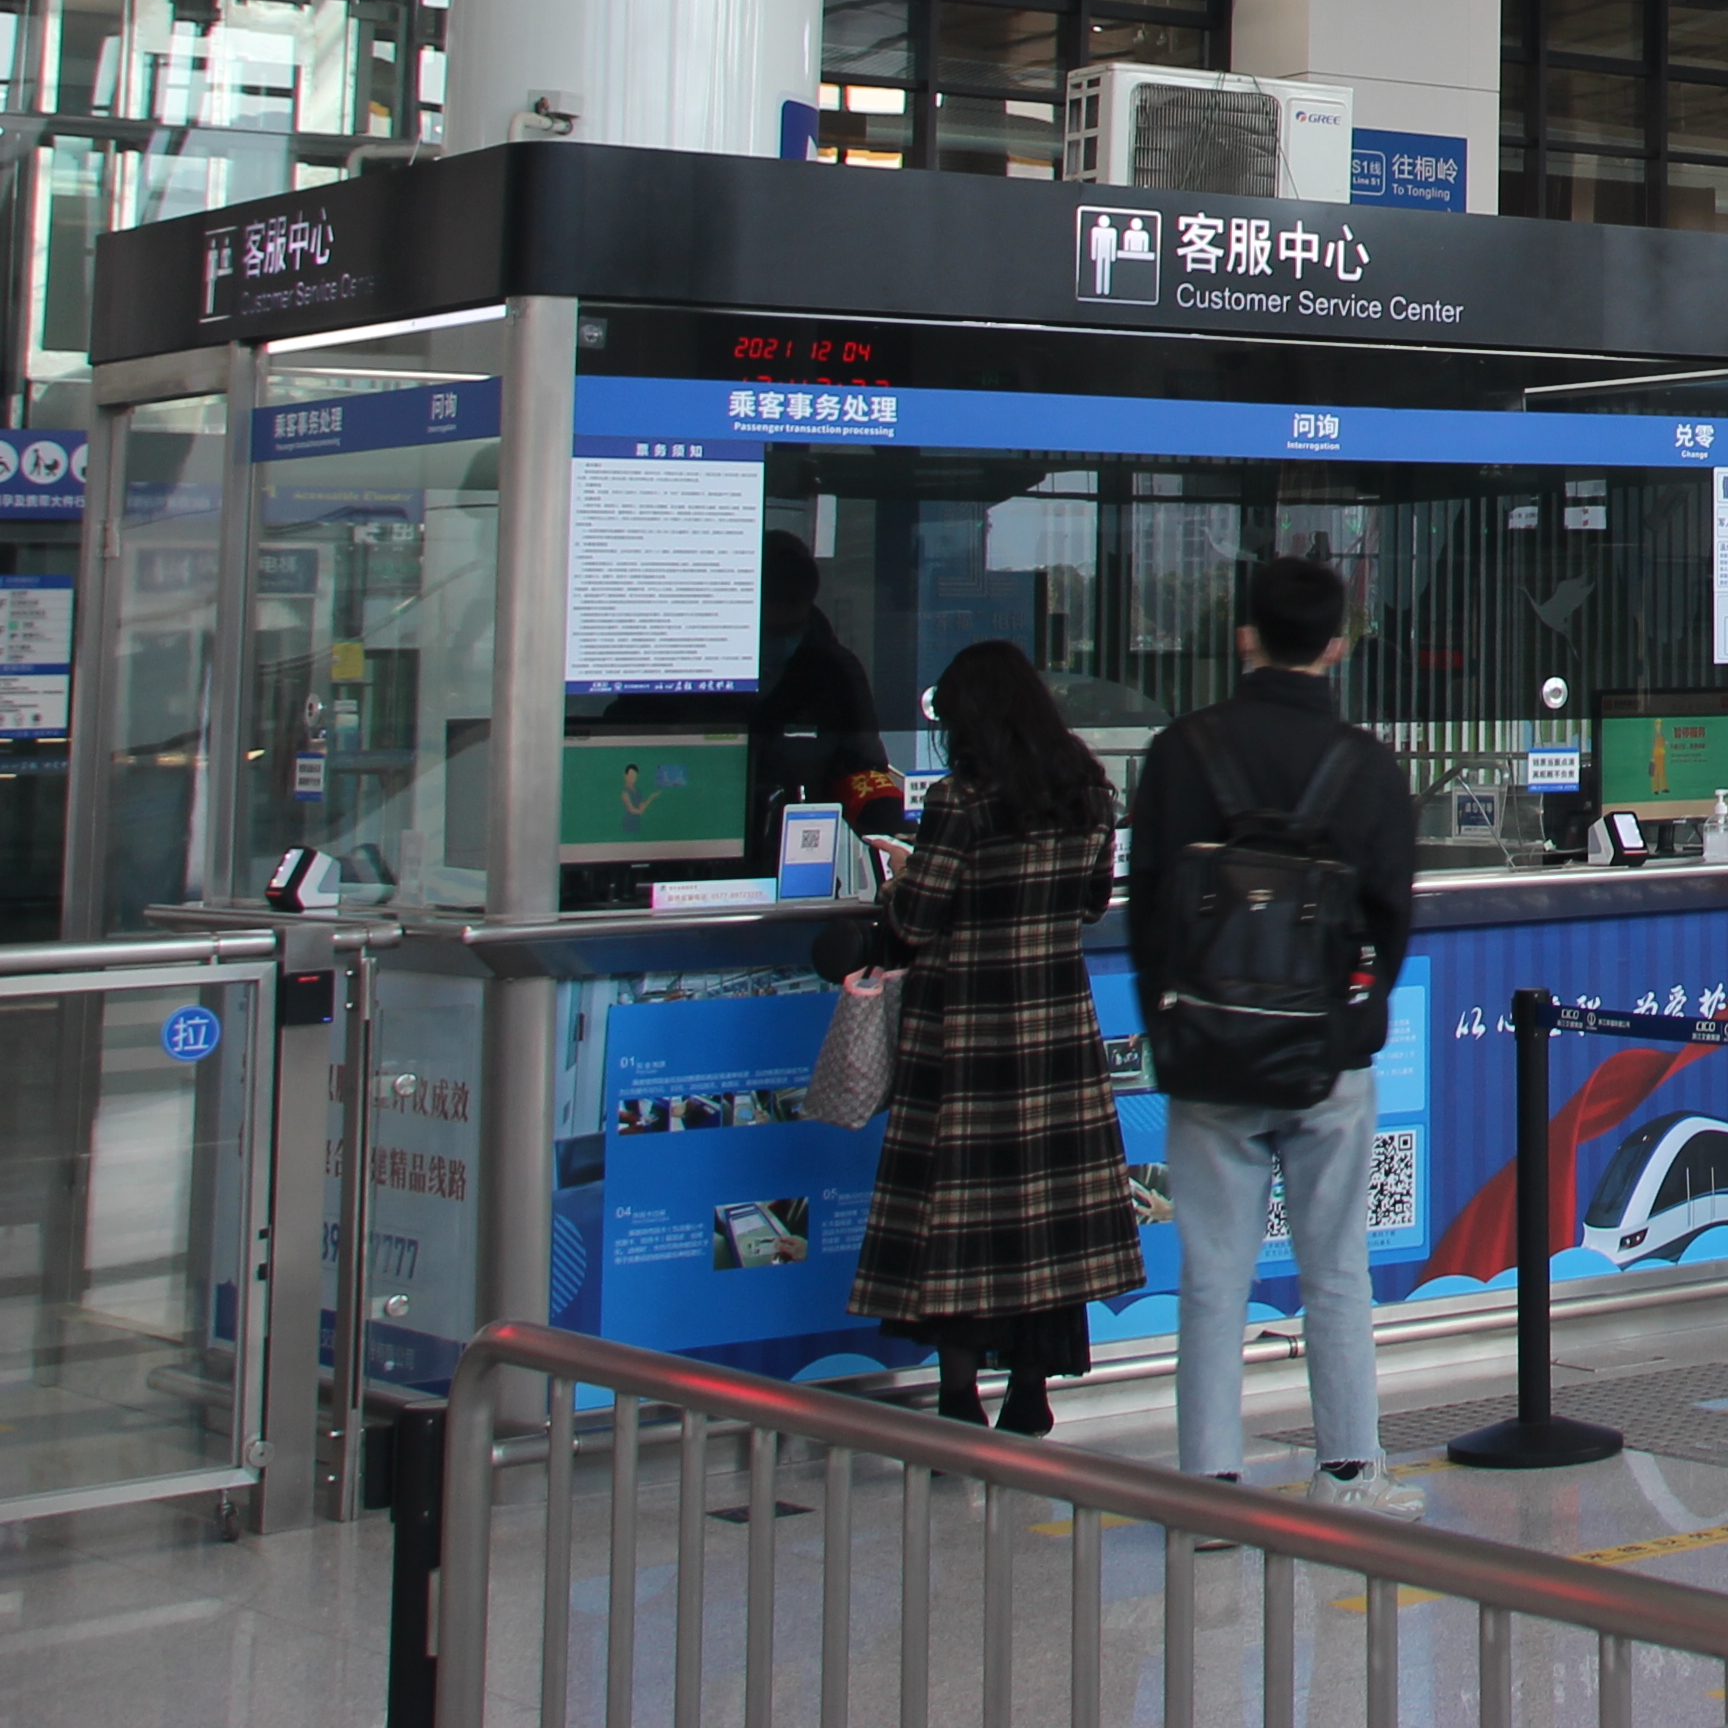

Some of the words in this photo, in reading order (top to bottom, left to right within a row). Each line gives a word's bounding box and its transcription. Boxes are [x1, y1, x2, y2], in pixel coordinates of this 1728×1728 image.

[1308, 113, 1341, 126] GREE
[1352, 159, 1382, 175] S1线
[1392, 153, 1459, 184] 往桐岭
[1371, 177, 1381, 186] S1
[1392, 184, 1404, 195] To
[1407, 185, 1450, 201] Tongling
[243, 208, 334, 279] 客服中心
[1176, 211, 1371, 283] 客服中心
[294, 280, 338, 306] Service
[1176, 283, 1291, 318] Customer
[1298, 288, 1383, 322] Service
[1390, 294, 1464, 325] Center
[734, 337, 793, 360] 2021
[811, 340, 832, 361] 12
[842, 342, 872, 362] 04
[431, 392, 457, 420] 问询
[728, 390, 898, 423] 乘客事务处理
[274, 407, 343, 439] 乘客事务处理
[733, 422, 784, 434] Passenger
[785, 423, 842, 436] transaction
[842, 425, 895, 438] processing
[1292, 412, 1339, 440] 问询
[1287, 440, 1340, 451] Interrogation
[1675, 424, 1715, 448] 兑零
[636, 442, 703, 458] 票务须知
[1681, 450, 1708, 459] Change
[852, 771, 894, 799] 安全
[1561, 1008, 1579, 1020] CICO
[171, 1016, 209, 1052] 拉
[1696, 1020, 1716, 1032] CICO
[620, 1056, 635, 1069] 01
[822, 1188, 838, 1200] 05
[615, 1207, 631, 1219] 04
